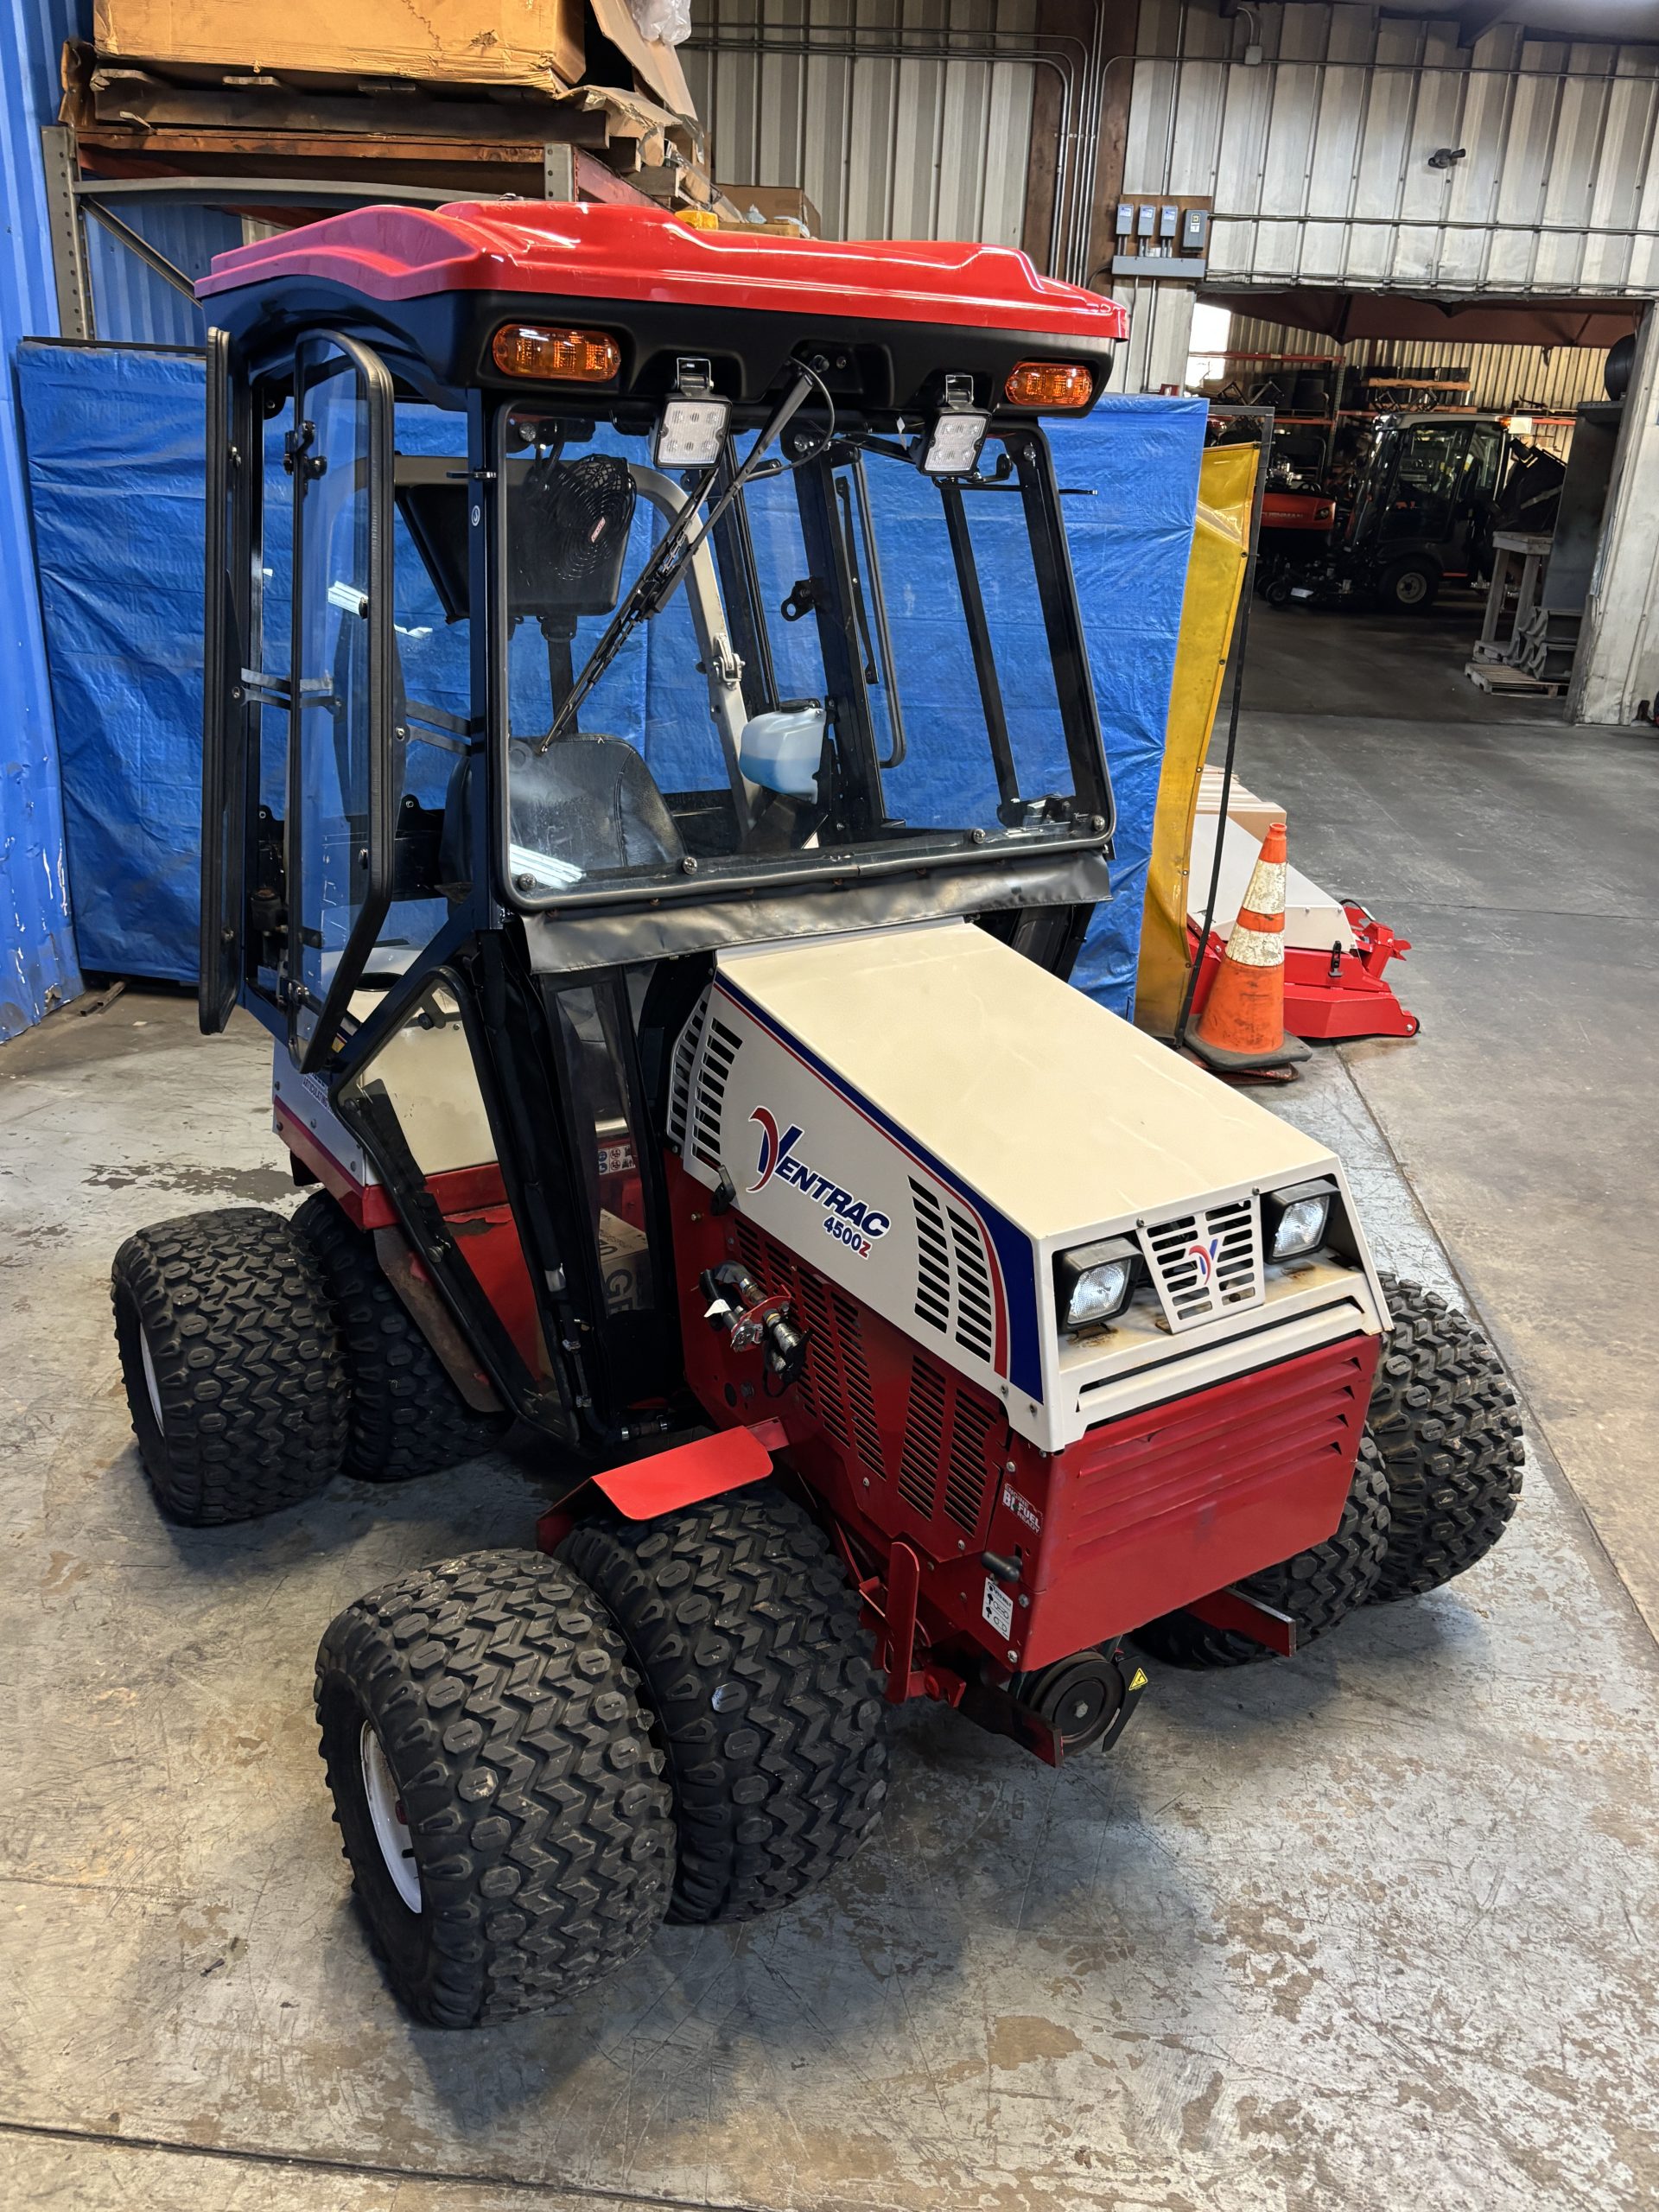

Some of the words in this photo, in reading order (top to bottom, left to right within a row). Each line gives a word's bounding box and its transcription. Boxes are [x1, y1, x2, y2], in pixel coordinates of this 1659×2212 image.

[746, 1106, 891, 1238] VENTRAC
[823, 1216, 871, 1259] 4500Z
[1018, 1503, 1040, 1529] FUEL
